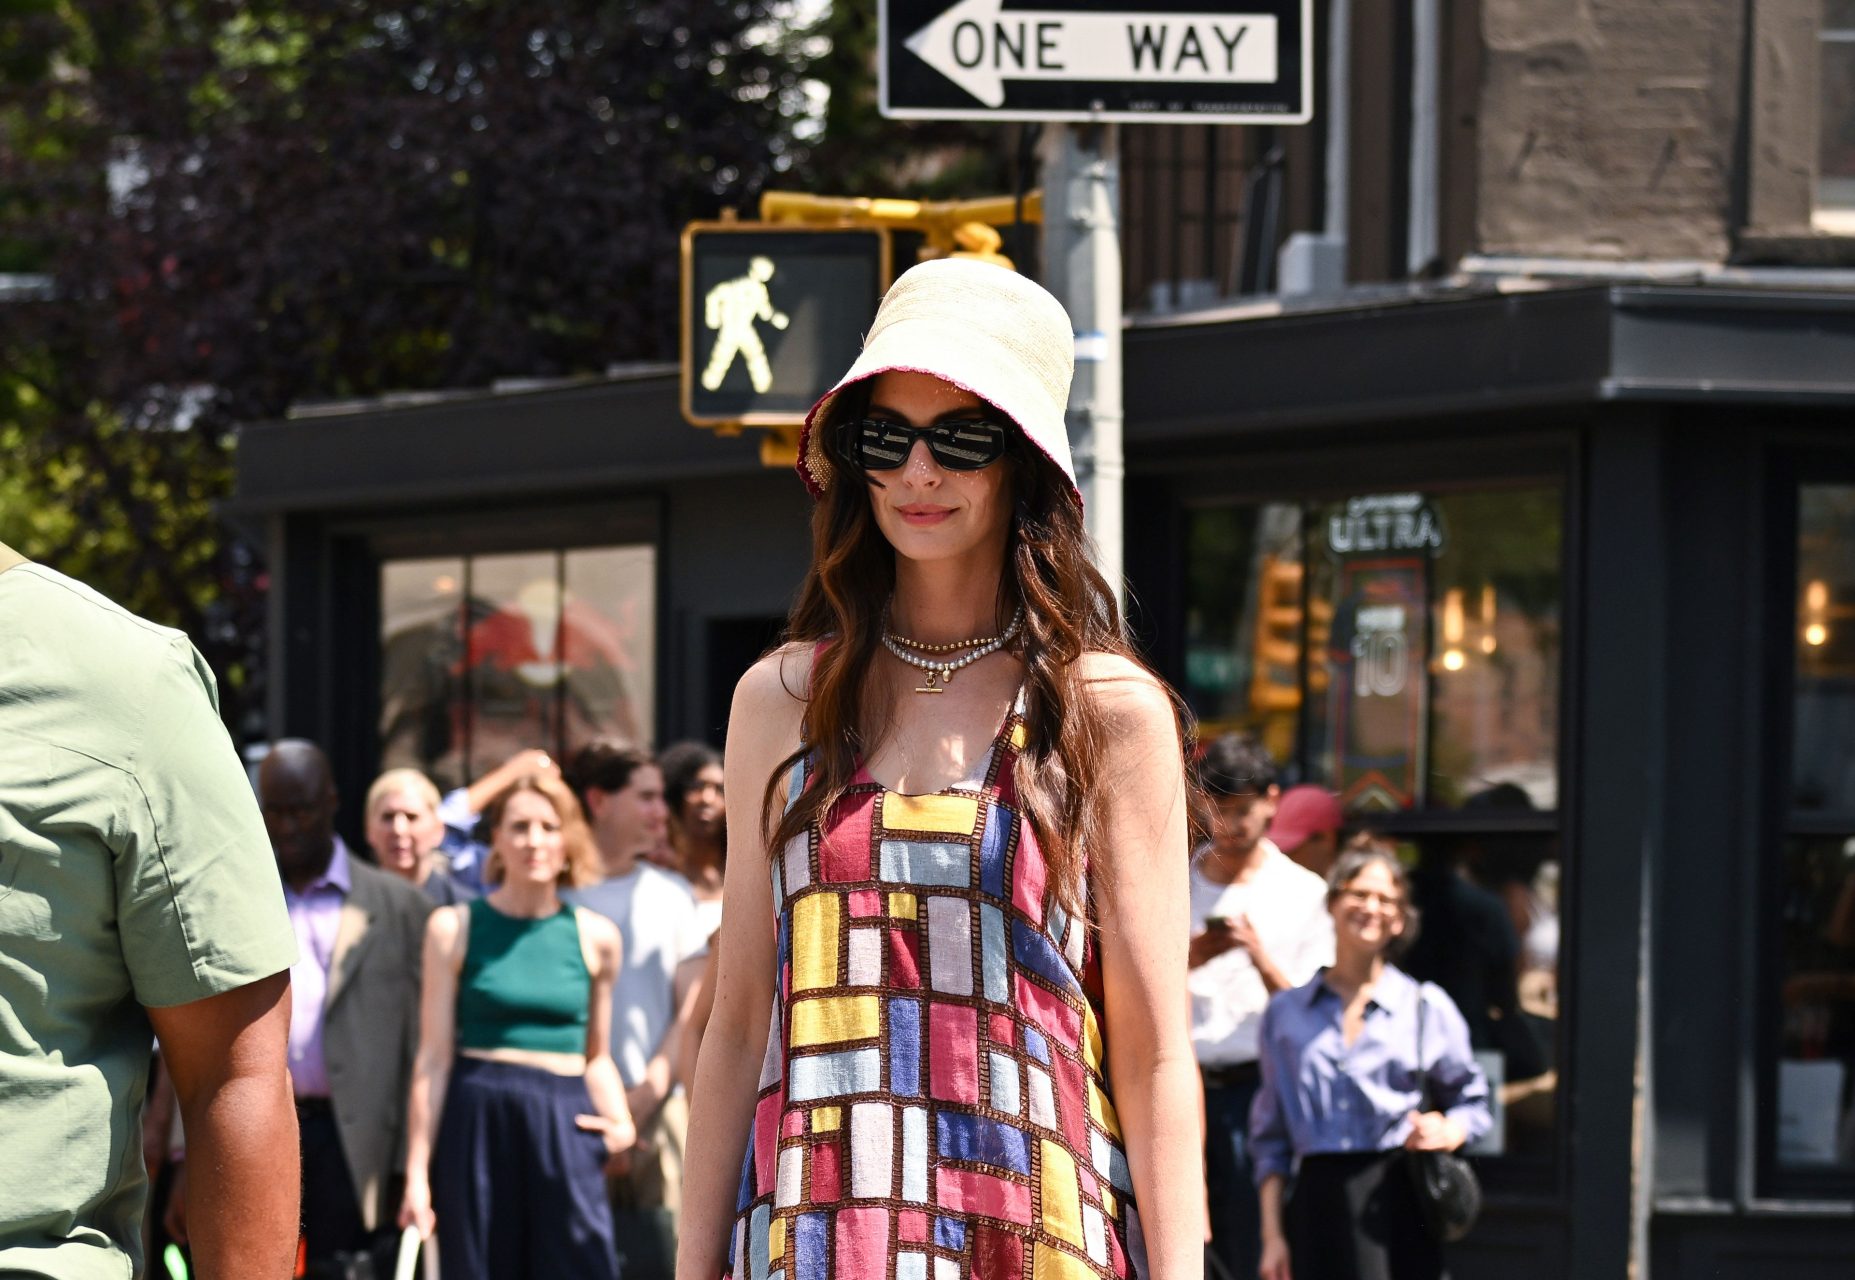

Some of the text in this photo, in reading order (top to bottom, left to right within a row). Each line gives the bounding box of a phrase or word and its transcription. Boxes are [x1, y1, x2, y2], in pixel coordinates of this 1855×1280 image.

[951, 20, 1248, 73] ONE WAY
[1329, 510, 1442, 552] ULTRA
